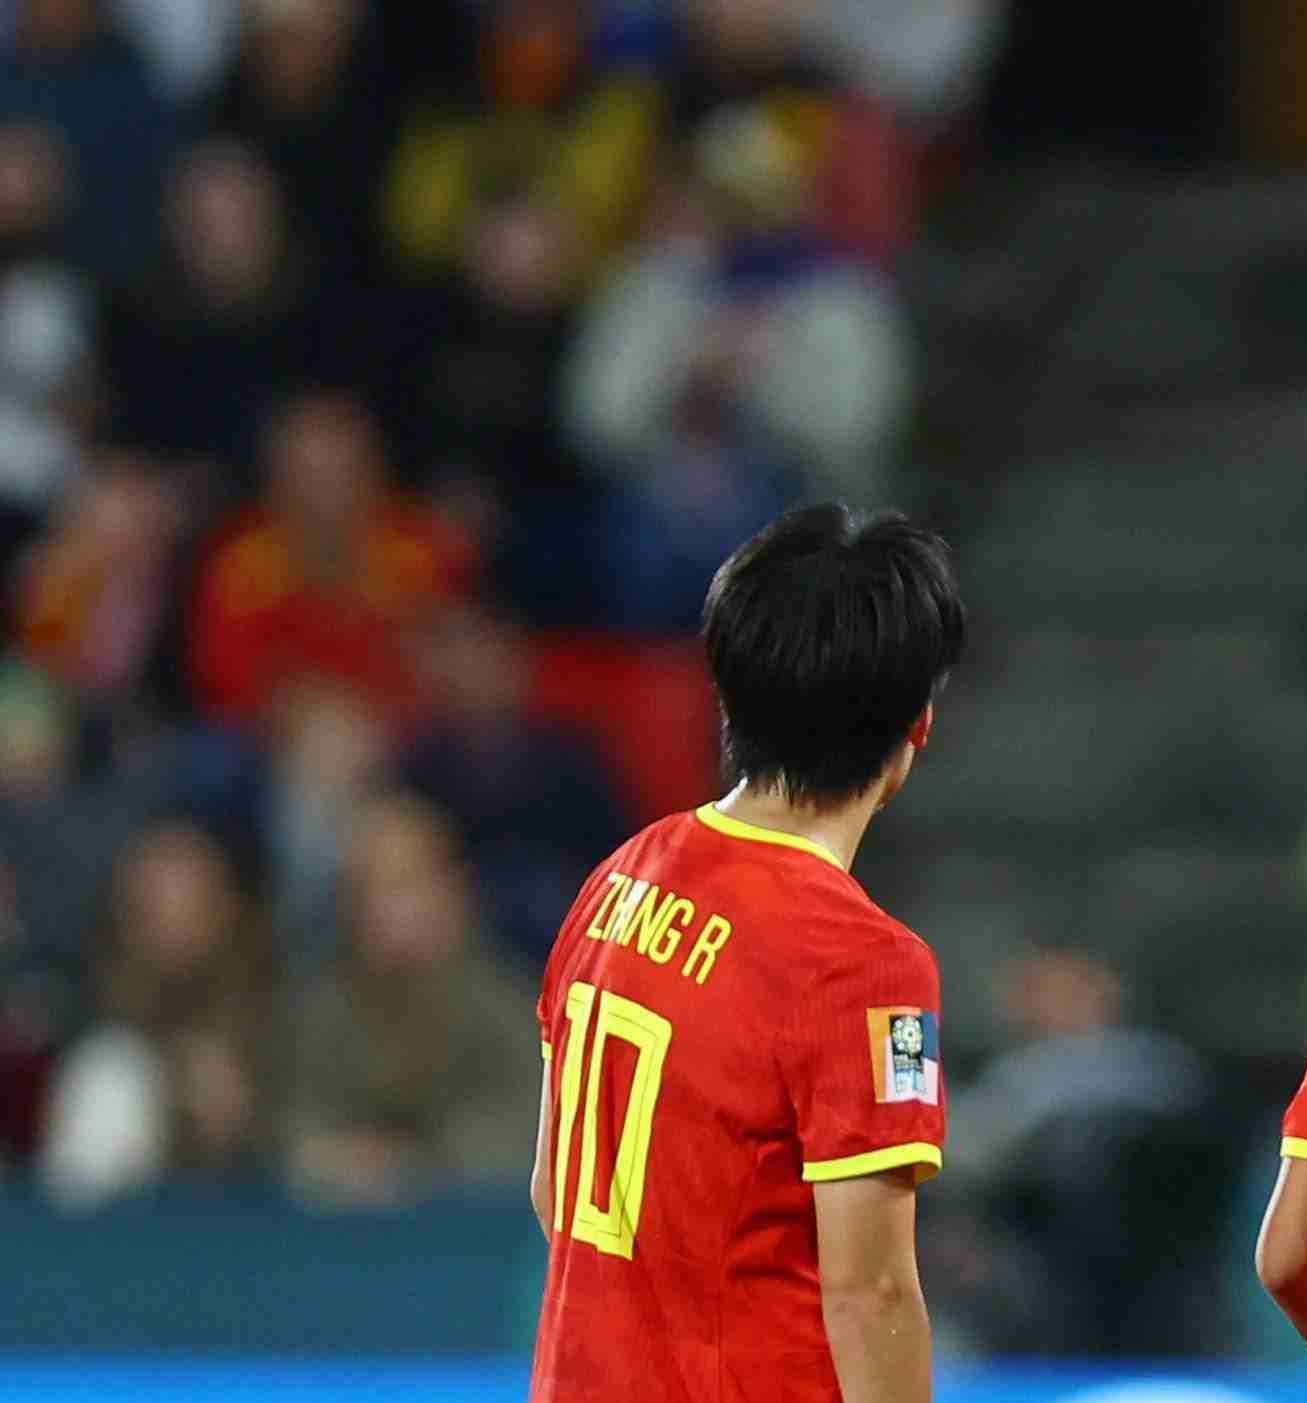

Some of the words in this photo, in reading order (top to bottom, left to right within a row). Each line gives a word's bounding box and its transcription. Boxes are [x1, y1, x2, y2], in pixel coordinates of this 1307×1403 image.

[586, 871, 696, 965] ZHNG
[681, 914, 734, 985] R
[553, 981, 673, 1261] 10
